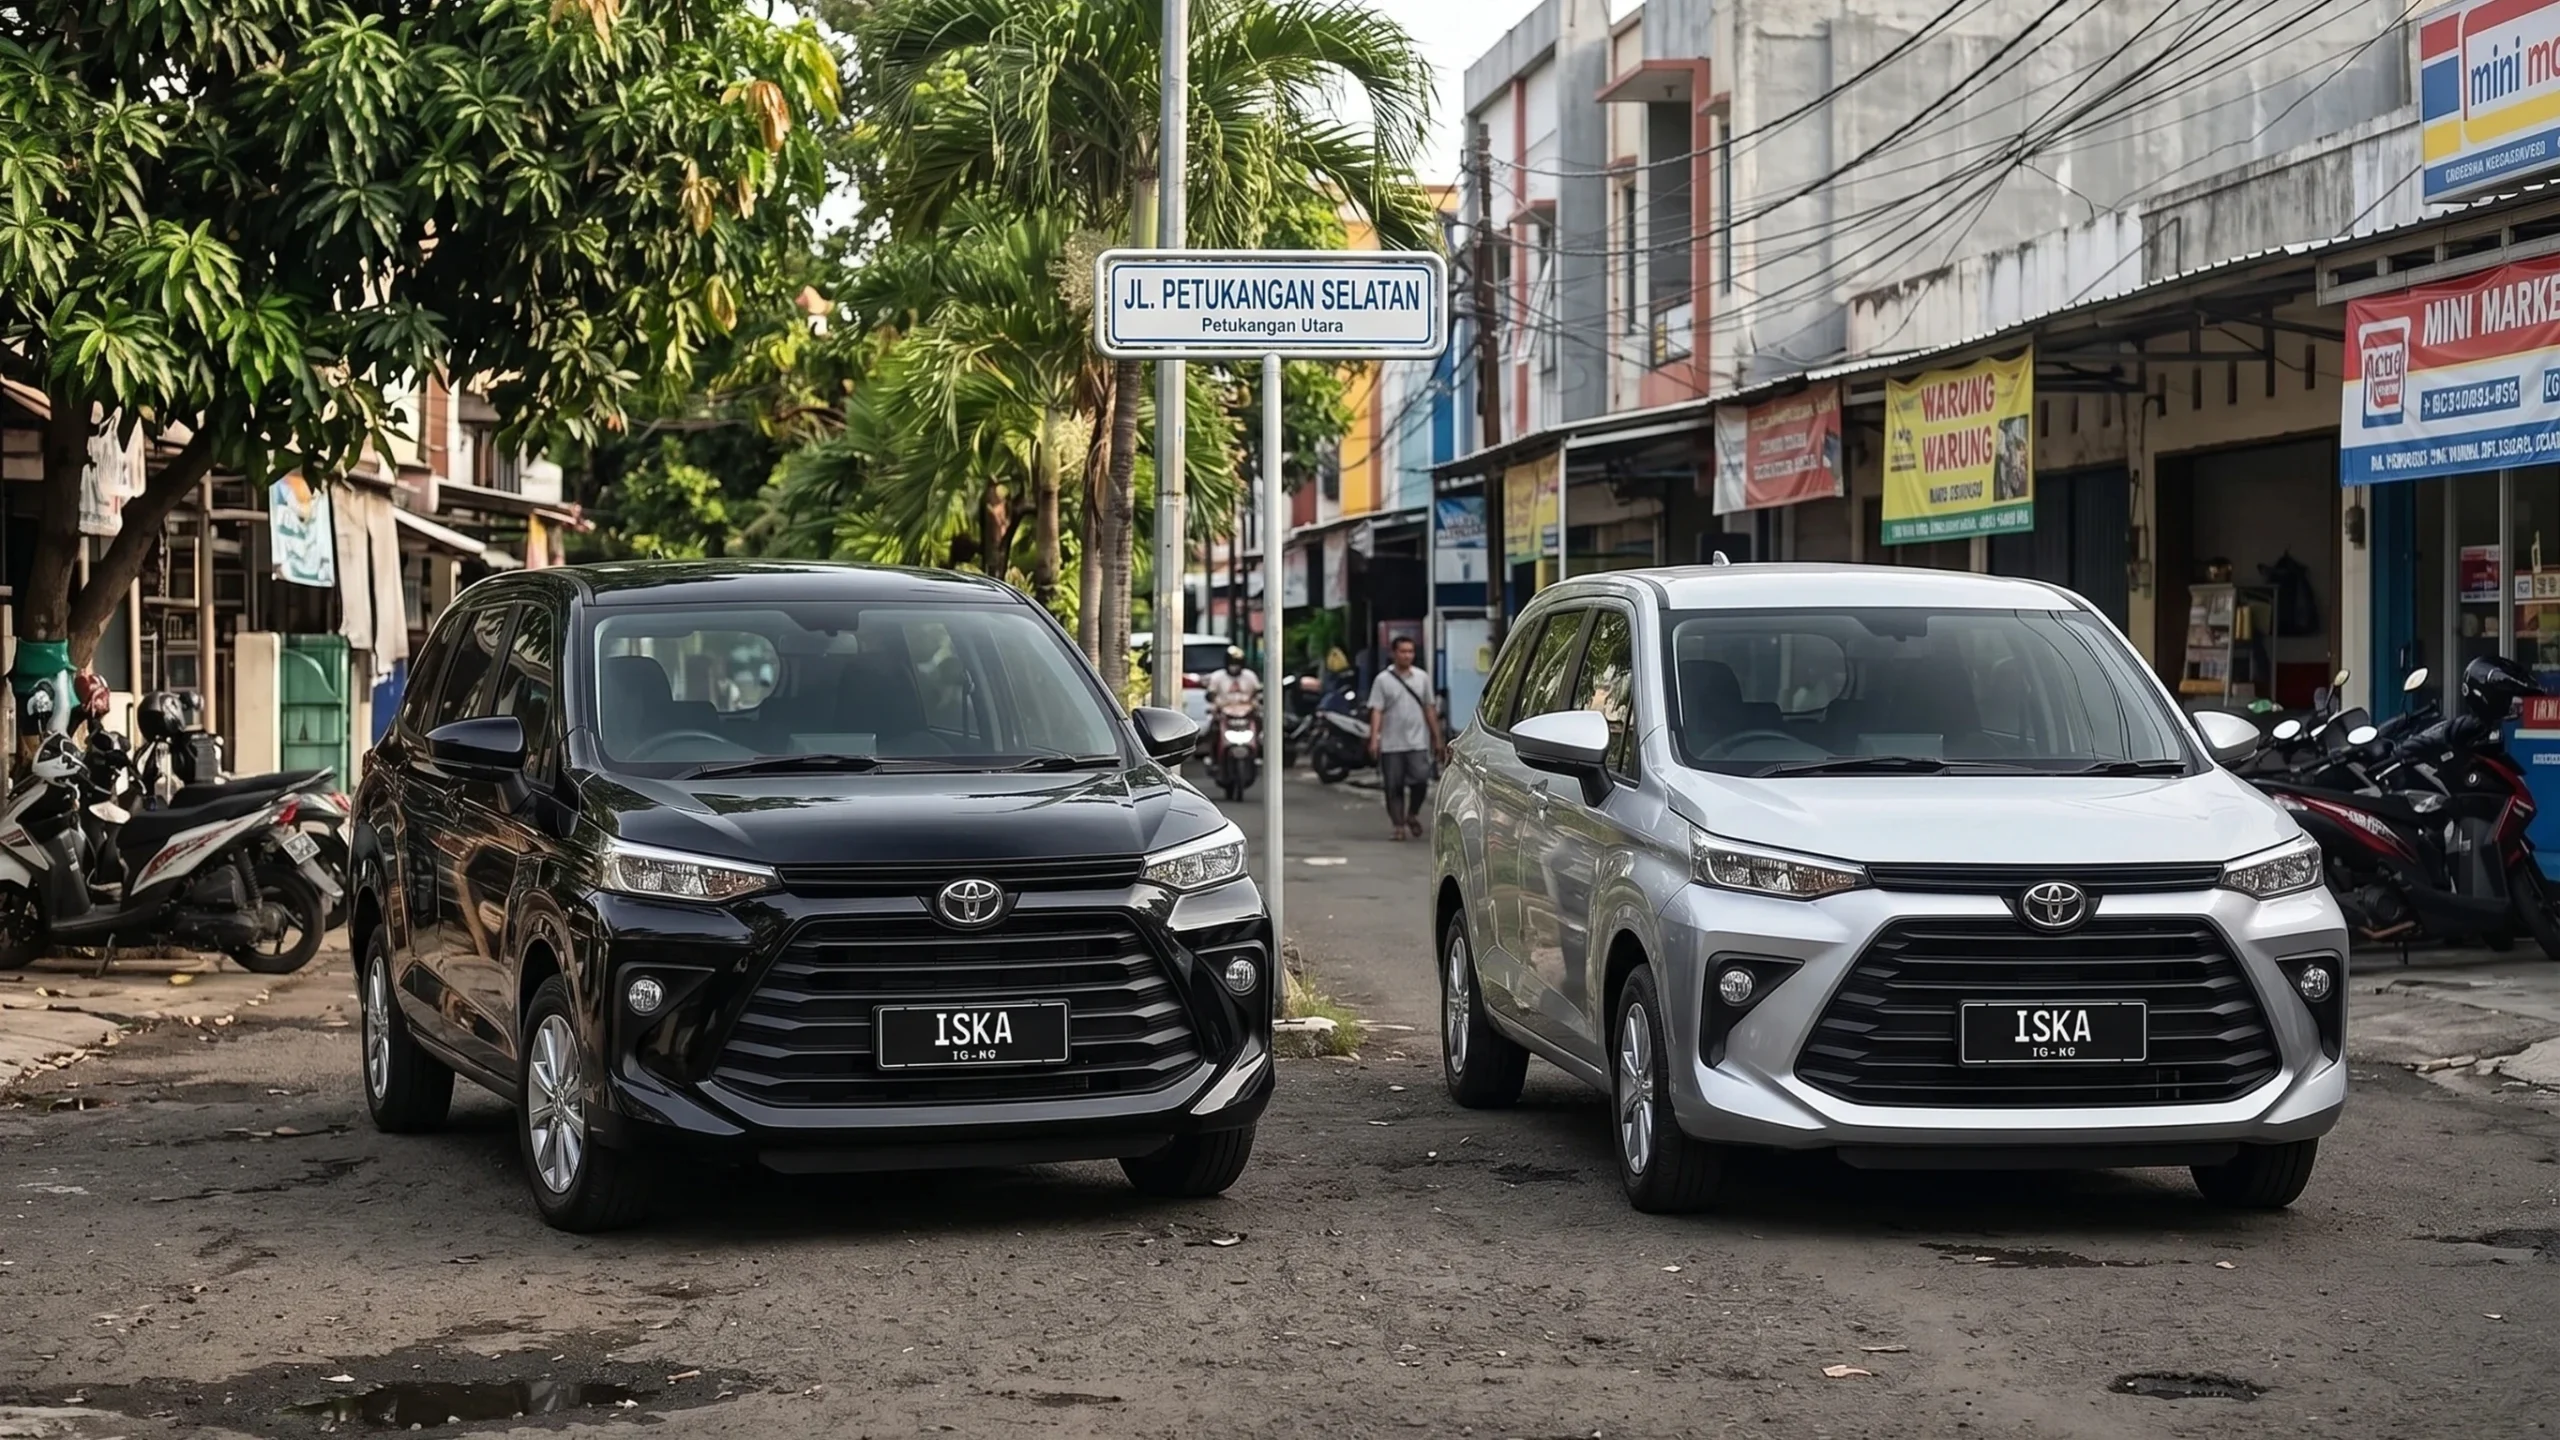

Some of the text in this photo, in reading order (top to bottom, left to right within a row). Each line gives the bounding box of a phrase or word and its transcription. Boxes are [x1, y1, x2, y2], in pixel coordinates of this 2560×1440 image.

[2471, 35, 2521, 107] mini
[1124, 279, 1420, 311] JL. PETUKANGAN SELATAN
[1202, 317, 1343, 336] Petukangan Utara
[2421, 294, 2473, 348] MINI
[1921, 372, 1995, 423] WARUNG
[1922, 425, 1993, 474] WARUNG
[935, 1011, 1013, 1046] ISKA
[2015, 1010, 2092, 1043] ISKA
